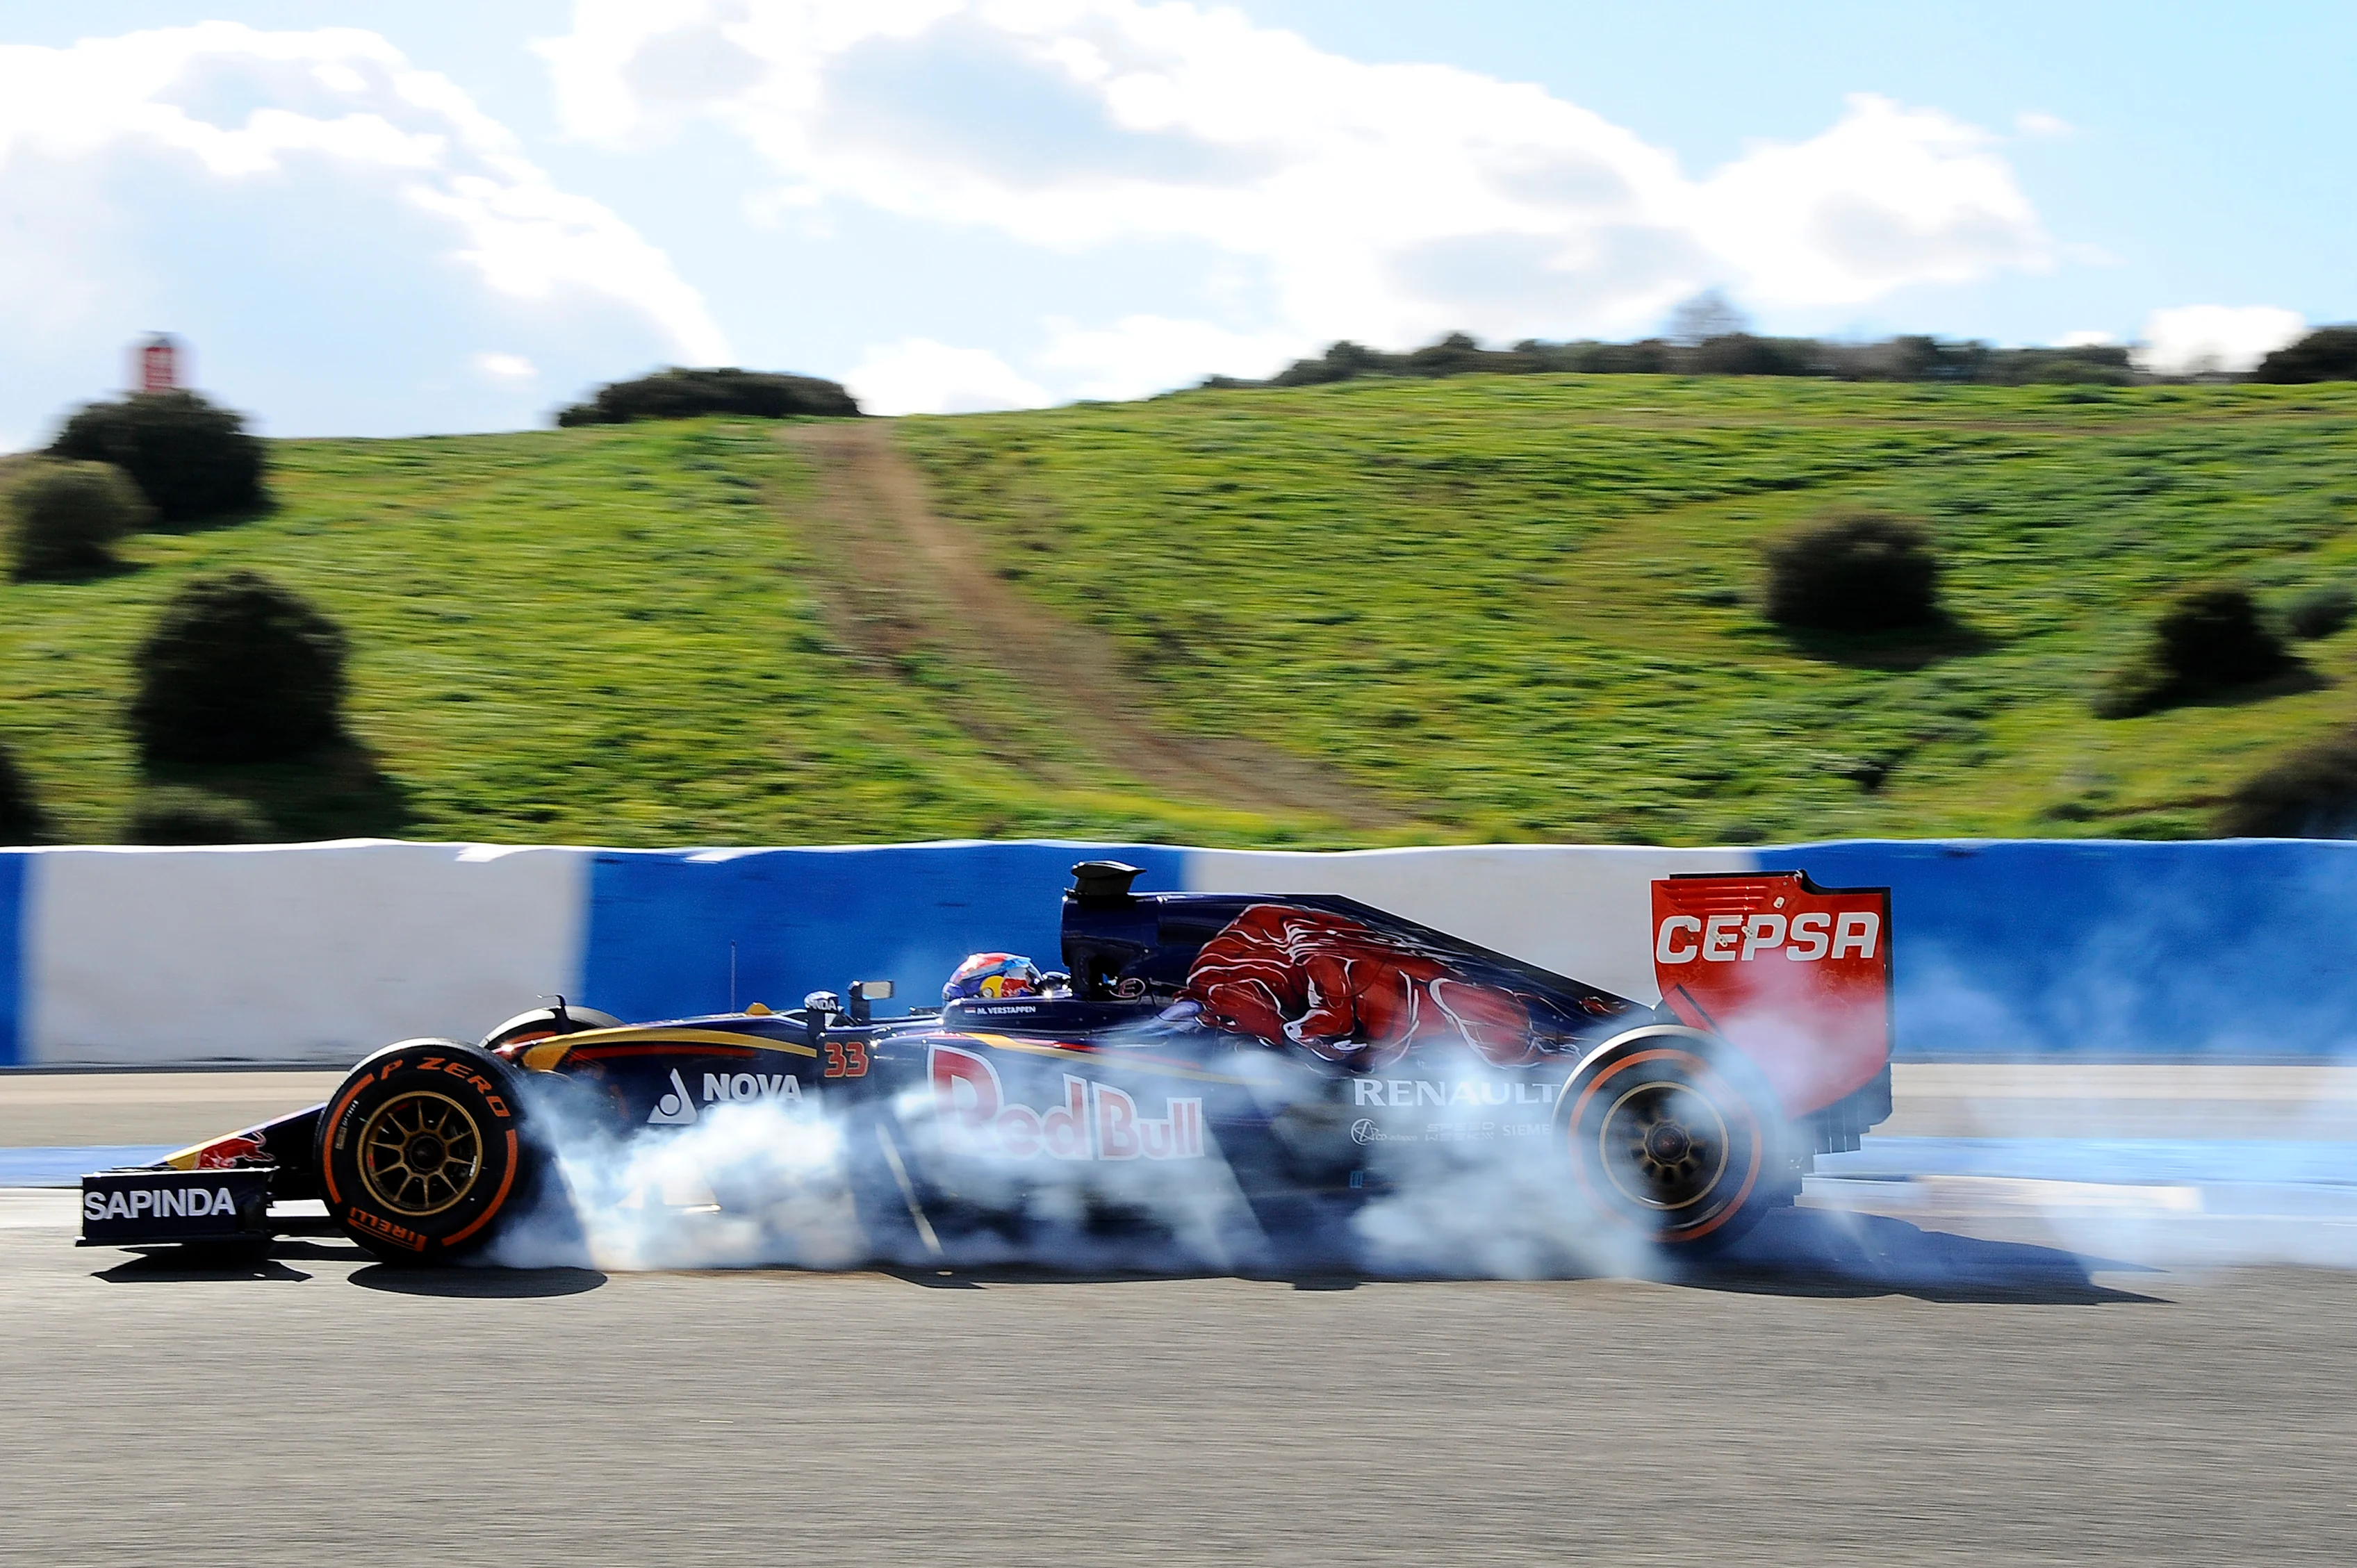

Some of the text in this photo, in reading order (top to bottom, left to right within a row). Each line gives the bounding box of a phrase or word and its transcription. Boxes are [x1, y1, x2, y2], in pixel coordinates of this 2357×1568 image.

[1656, 911, 1880, 964] CEPSA
[976, 1006, 1036, 1015] M. VERSTAPPEN
[824, 1041, 869, 1078] 33
[381, 1057, 511, 1117] P ZERO
[703, 1073, 804, 1103] NOVA
[927, 1044, 1205, 1161] Red Bull
[1353, 1078, 1561, 1107] RENAULT
[1502, 1124, 1551, 1137] SIEME
[83, 1187, 237, 1221] SAPINDA
[347, 1206, 427, 1252] PIRELLI
